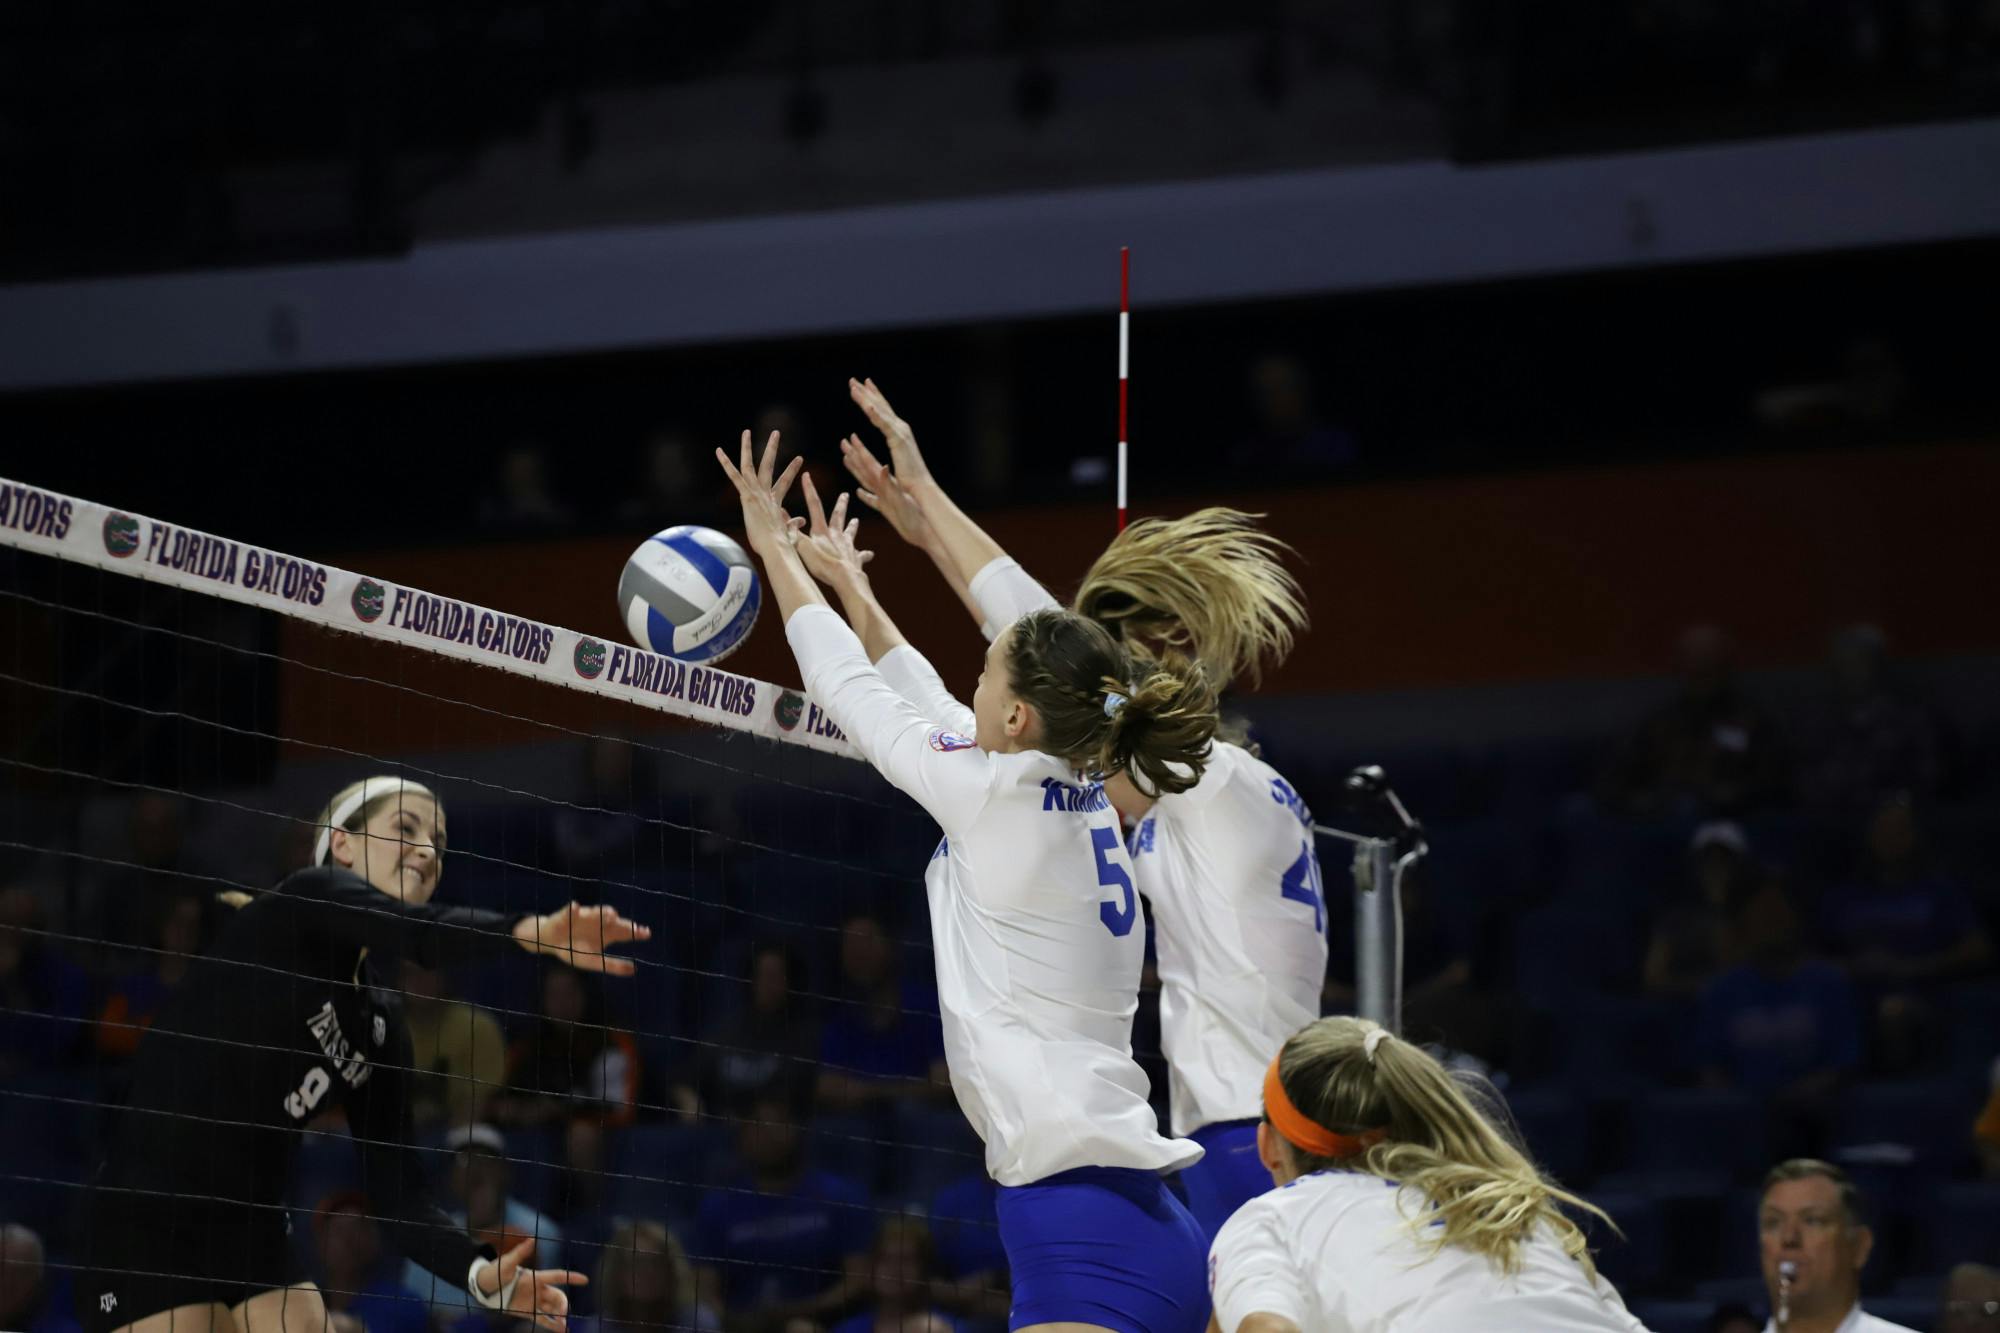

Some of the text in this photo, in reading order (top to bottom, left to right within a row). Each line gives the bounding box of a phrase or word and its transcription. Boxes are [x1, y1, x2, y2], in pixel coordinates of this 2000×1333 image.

[146, 521, 238, 585] FLORIDA
[242, 549, 326, 606] GATORS
[388, 587, 554, 665] FLORIDA GATORS
[607, 646, 755, 716] FLORIDA GATORS
[1090, 826, 1137, 938] 5
